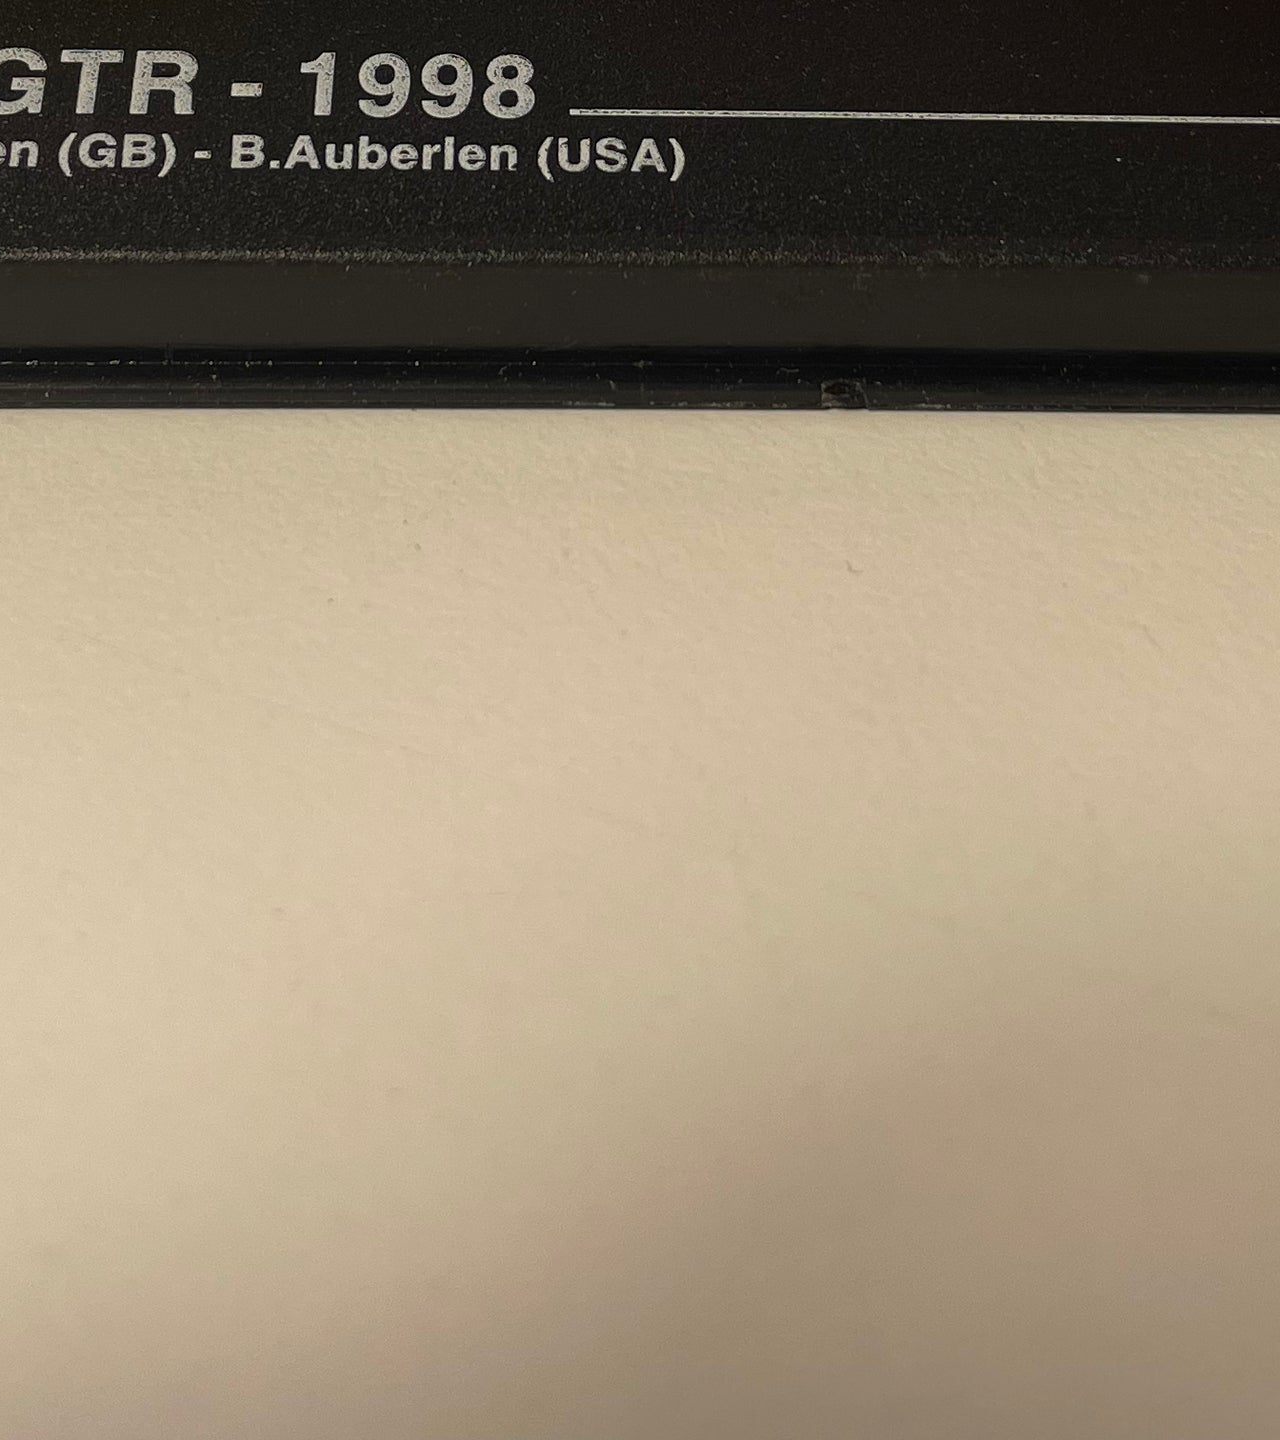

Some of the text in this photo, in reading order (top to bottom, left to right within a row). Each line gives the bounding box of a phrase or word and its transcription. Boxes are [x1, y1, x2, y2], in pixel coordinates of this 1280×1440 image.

[300, 51, 537, 119] 1998
[57, 130, 178, 178] (GB)
[230, 134, 519, 173] B.Auberlen
[536, 134, 686, 183] (USA)
